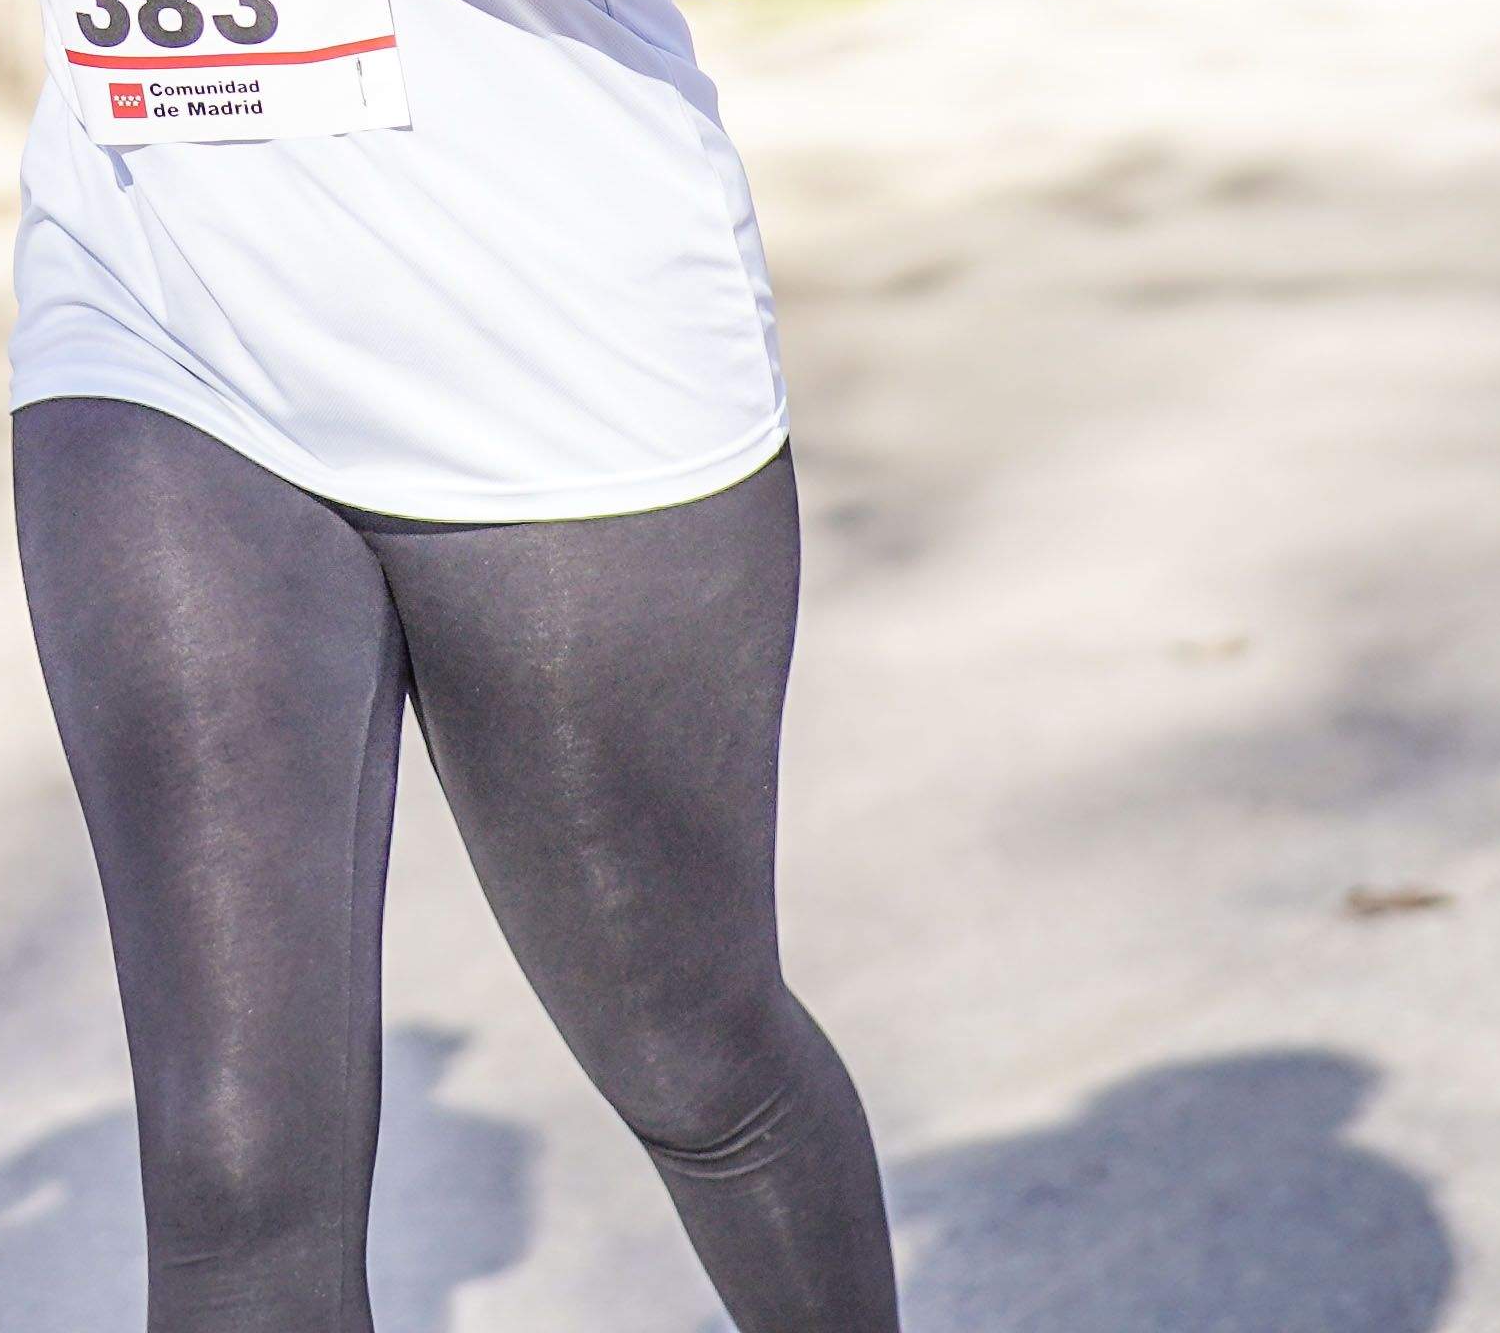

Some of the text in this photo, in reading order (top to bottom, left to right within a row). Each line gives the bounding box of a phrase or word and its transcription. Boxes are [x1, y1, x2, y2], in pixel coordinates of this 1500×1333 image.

[149, 80, 261, 97] Comunidad
[153, 100, 264, 118] de Madrid
